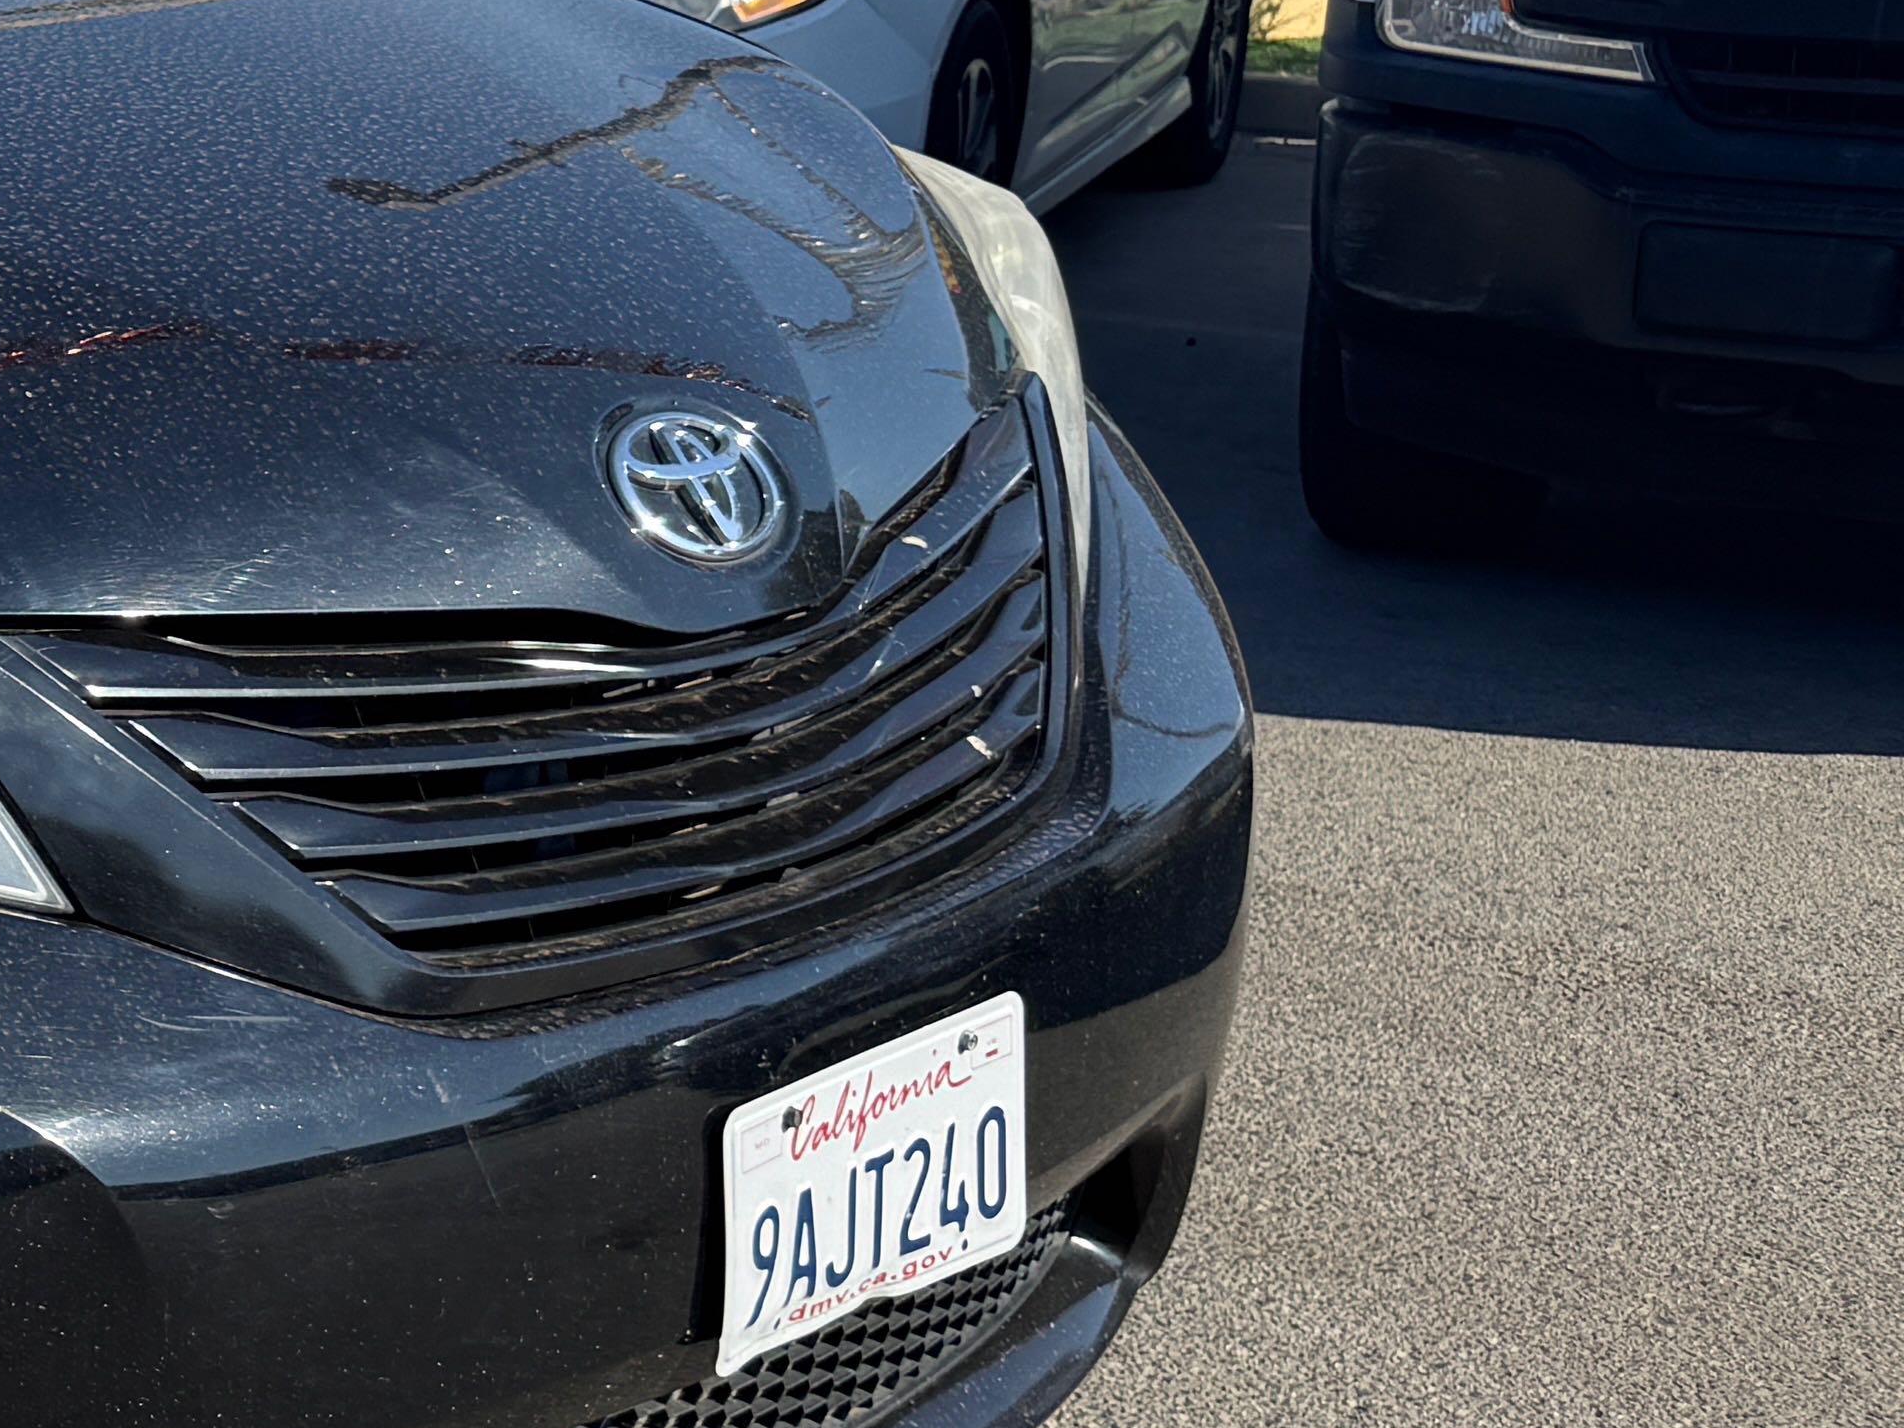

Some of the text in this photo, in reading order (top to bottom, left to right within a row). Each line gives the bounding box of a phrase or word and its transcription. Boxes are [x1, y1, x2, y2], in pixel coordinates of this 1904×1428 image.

[791, 1048, 972, 1161] California
[745, 1105, 1007, 1330] 9AJT240
[788, 1246, 953, 1323] dmv.ca.gov
